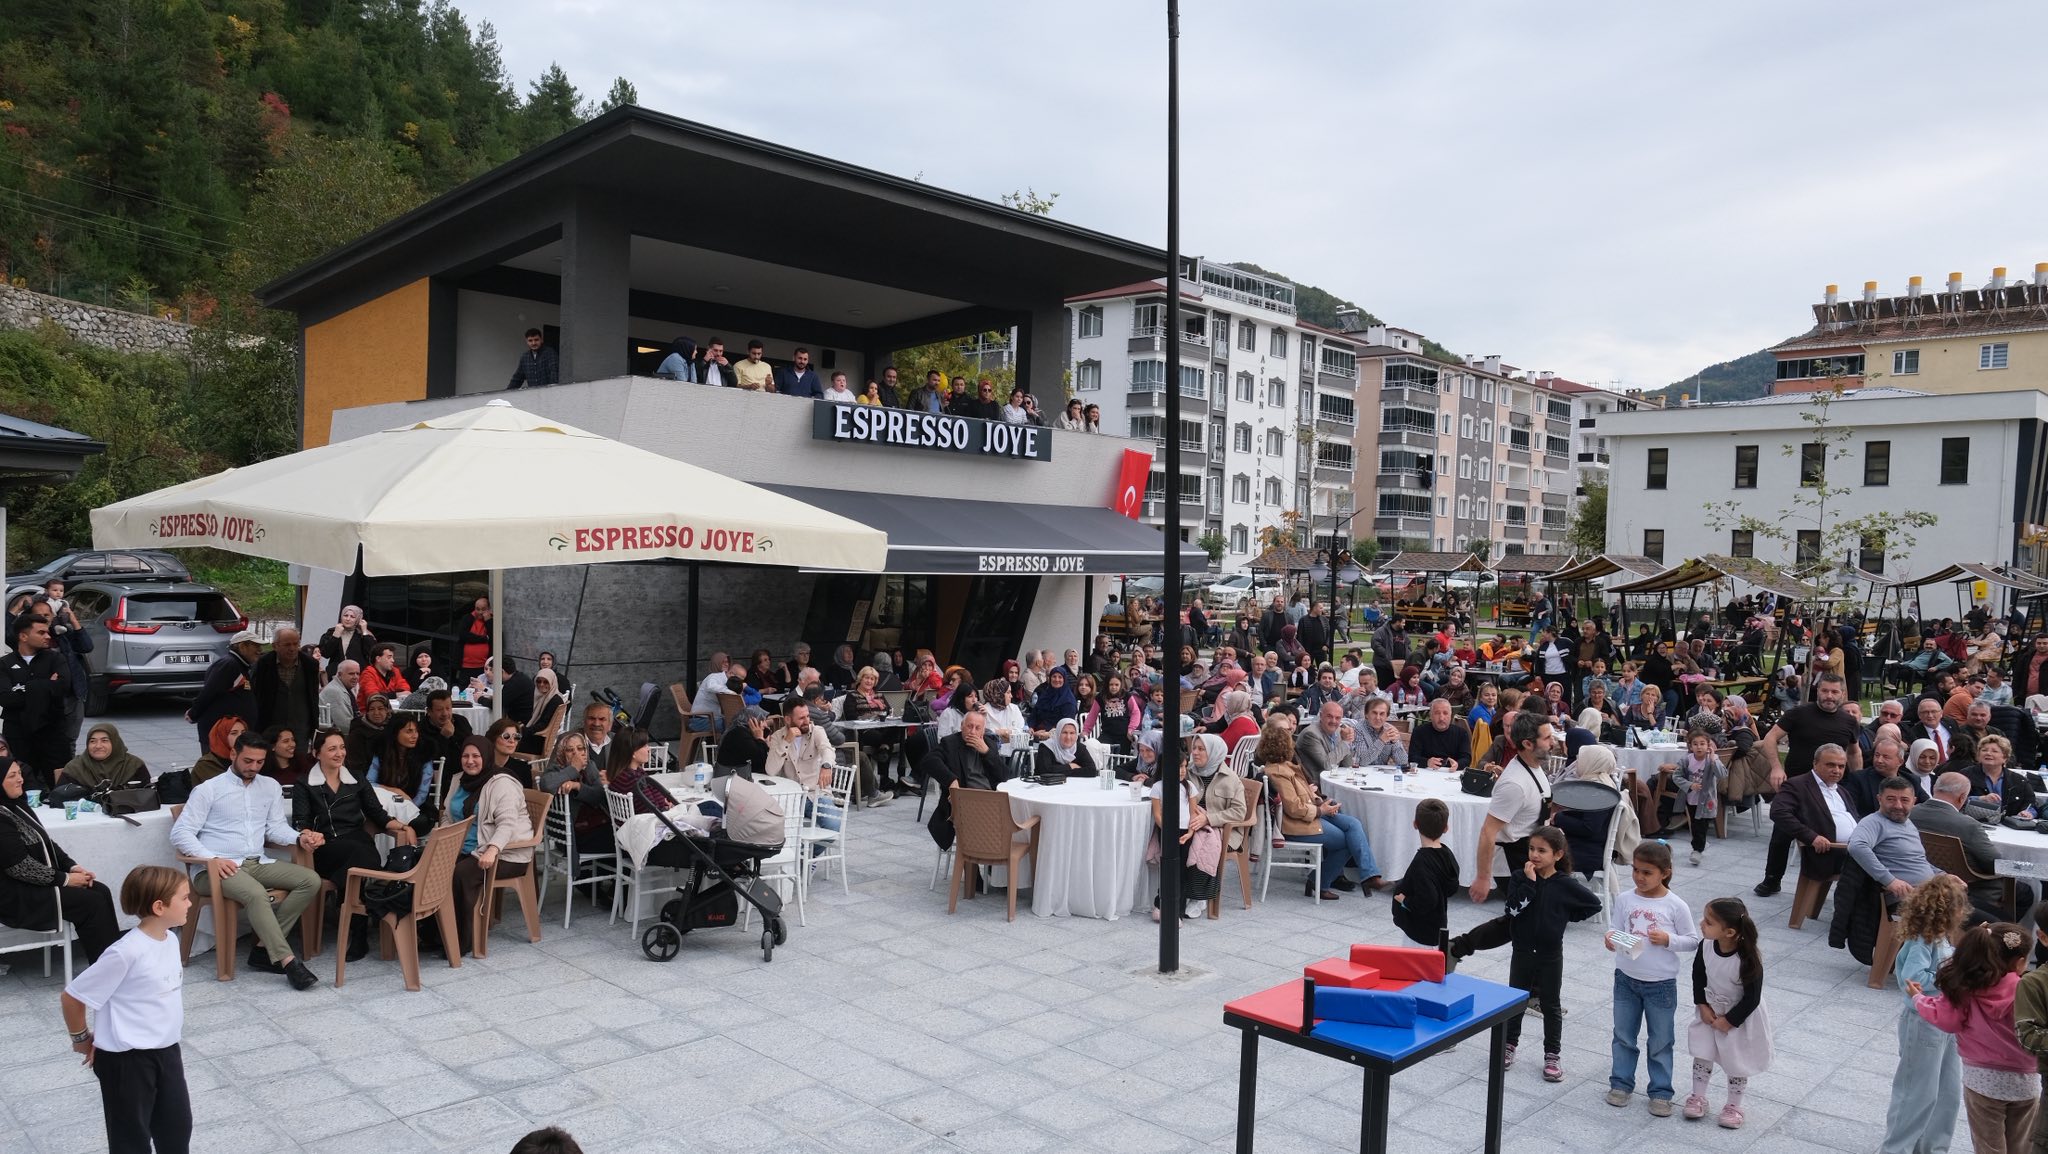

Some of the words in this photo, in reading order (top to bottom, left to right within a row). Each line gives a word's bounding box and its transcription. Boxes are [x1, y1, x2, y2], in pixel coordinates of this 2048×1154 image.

[834, 404, 969, 450] ESPRESSO
[983, 421, 1039, 457] JOYE
[160, 513, 218, 538] ESPRESSO
[221, 516, 254, 544] JOYE
[575, 525, 694, 553] ESPRESSO
[700, 529, 754, 553] JOYE
[979, 555, 1049, 572] ESPRESSO
[1052, 556, 1084, 572] JOYE
